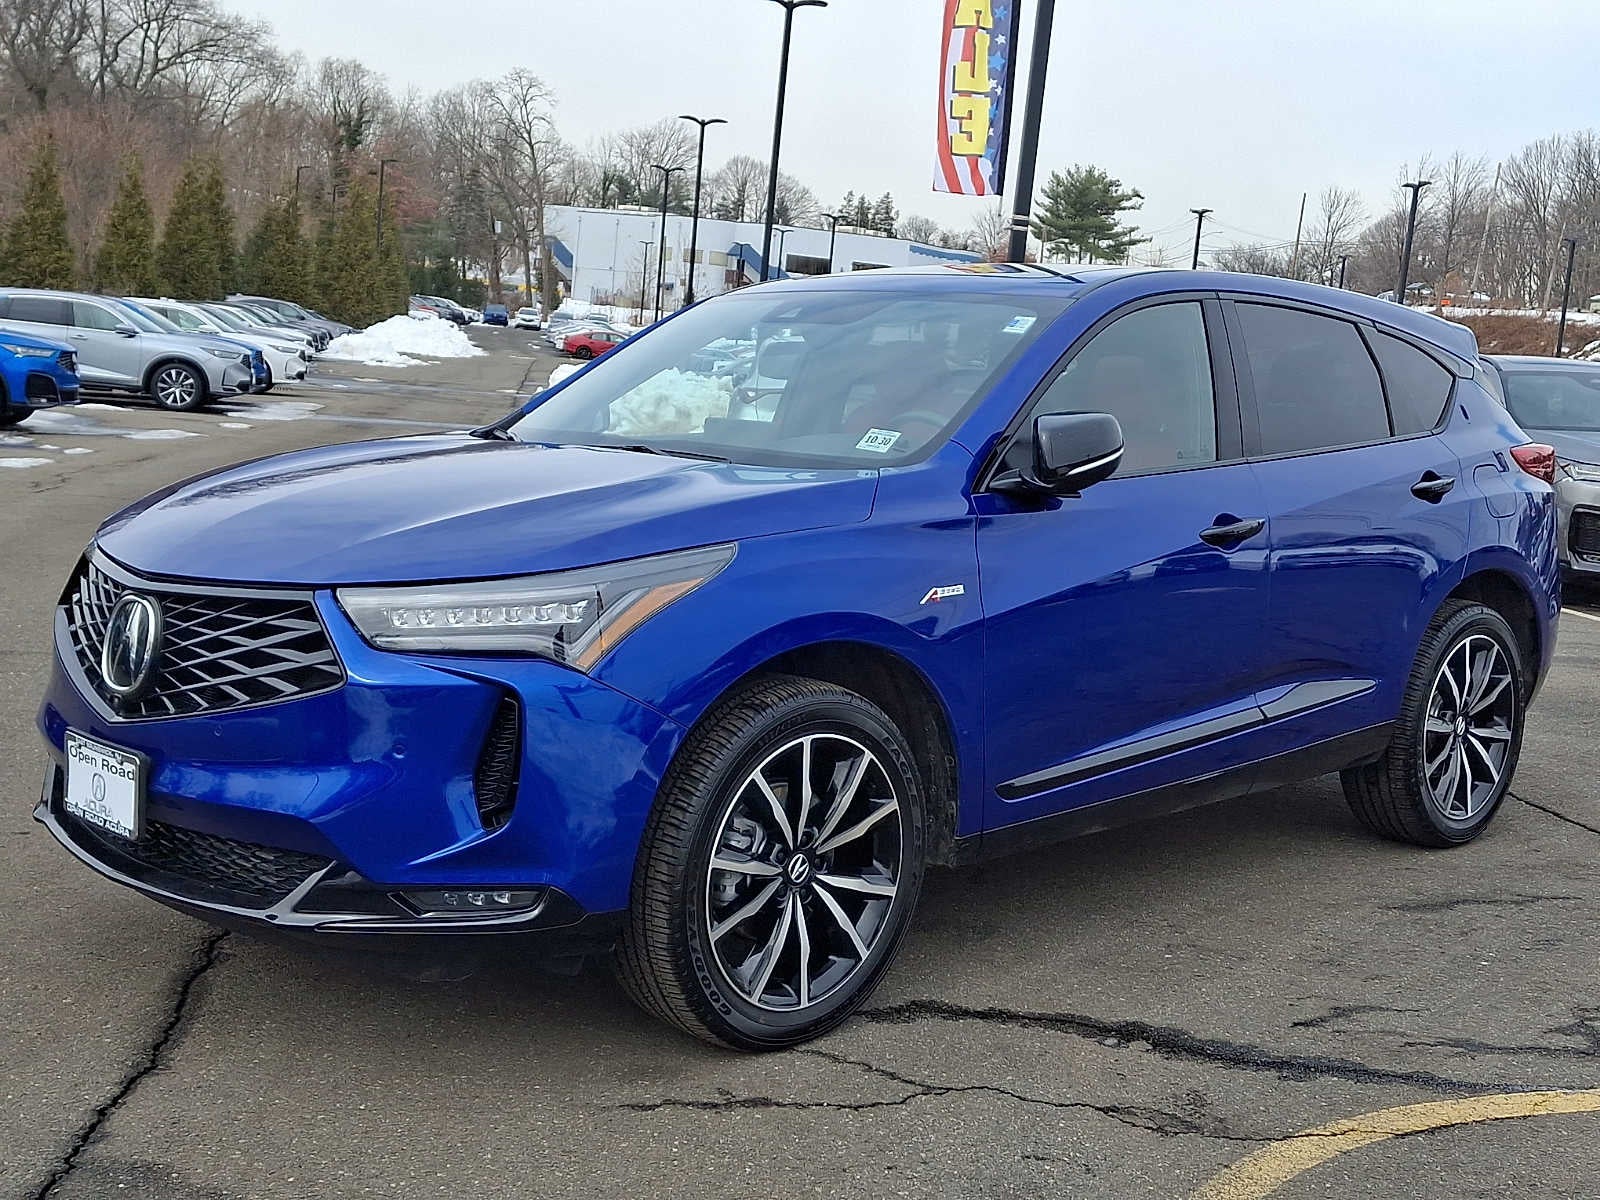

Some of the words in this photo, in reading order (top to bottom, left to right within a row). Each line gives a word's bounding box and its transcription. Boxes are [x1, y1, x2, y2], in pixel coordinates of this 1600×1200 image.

[69, 745, 97, 767] Open
[101, 758, 135, 780] Road
[84, 812, 105, 827] ROAD
[105, 820, 130, 838] ACURA
[686, 878, 732, 1016] GOODYE
